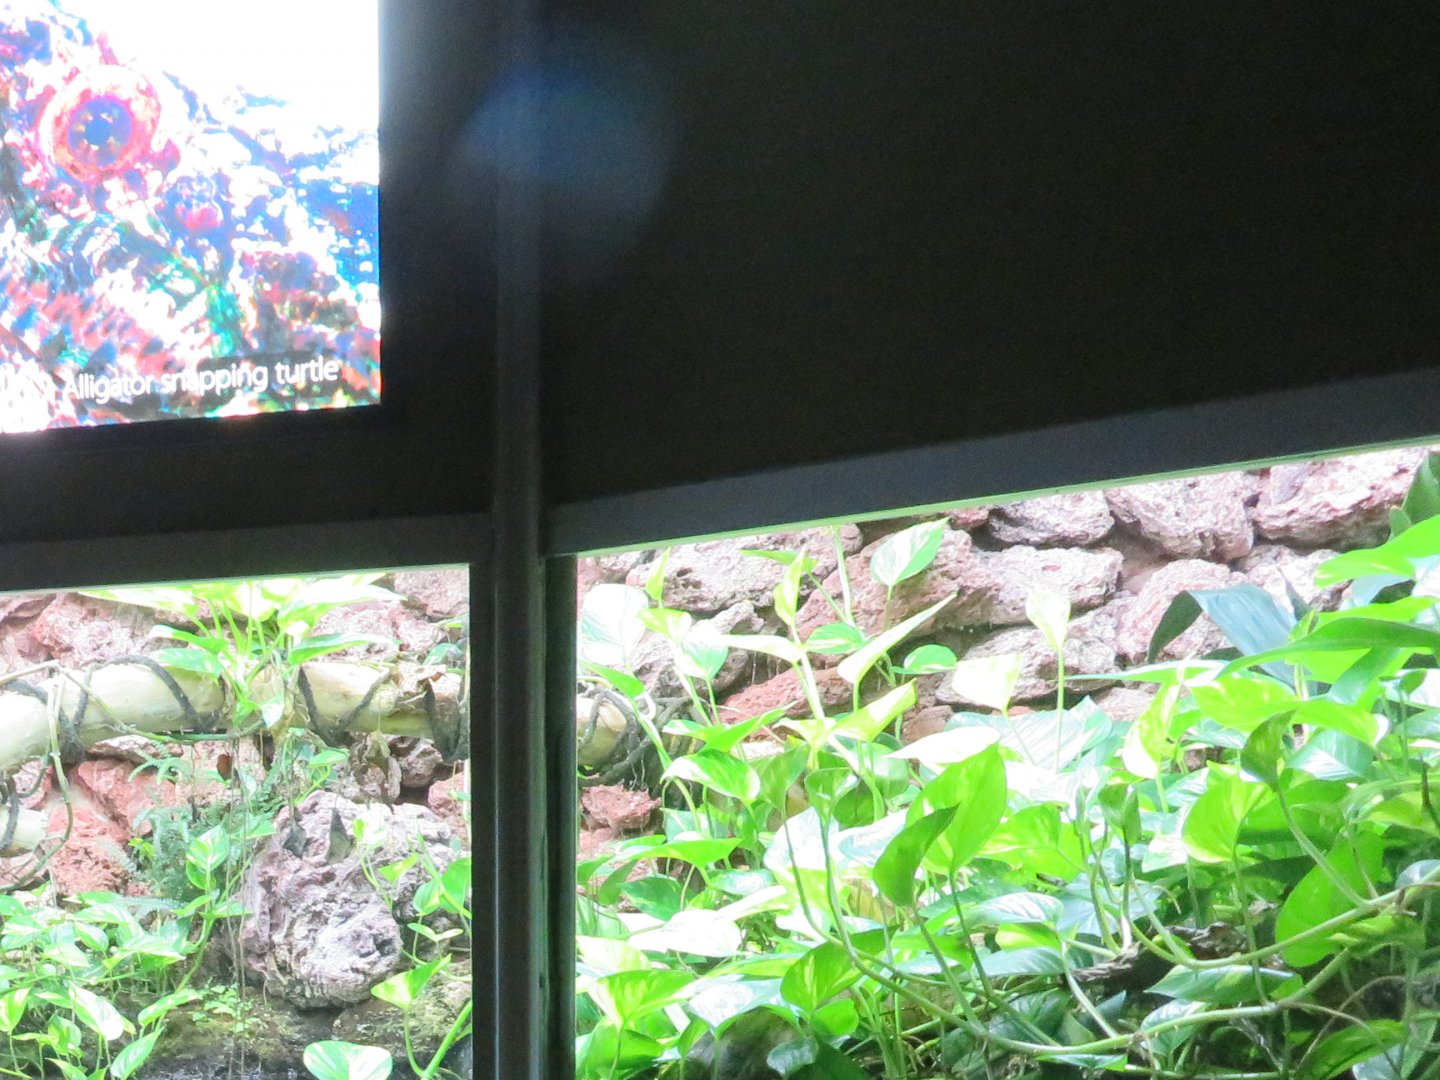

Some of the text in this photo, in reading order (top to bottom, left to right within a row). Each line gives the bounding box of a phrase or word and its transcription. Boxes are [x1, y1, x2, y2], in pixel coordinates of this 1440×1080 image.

[62, 354, 340, 405] Alligator snapping turtle
